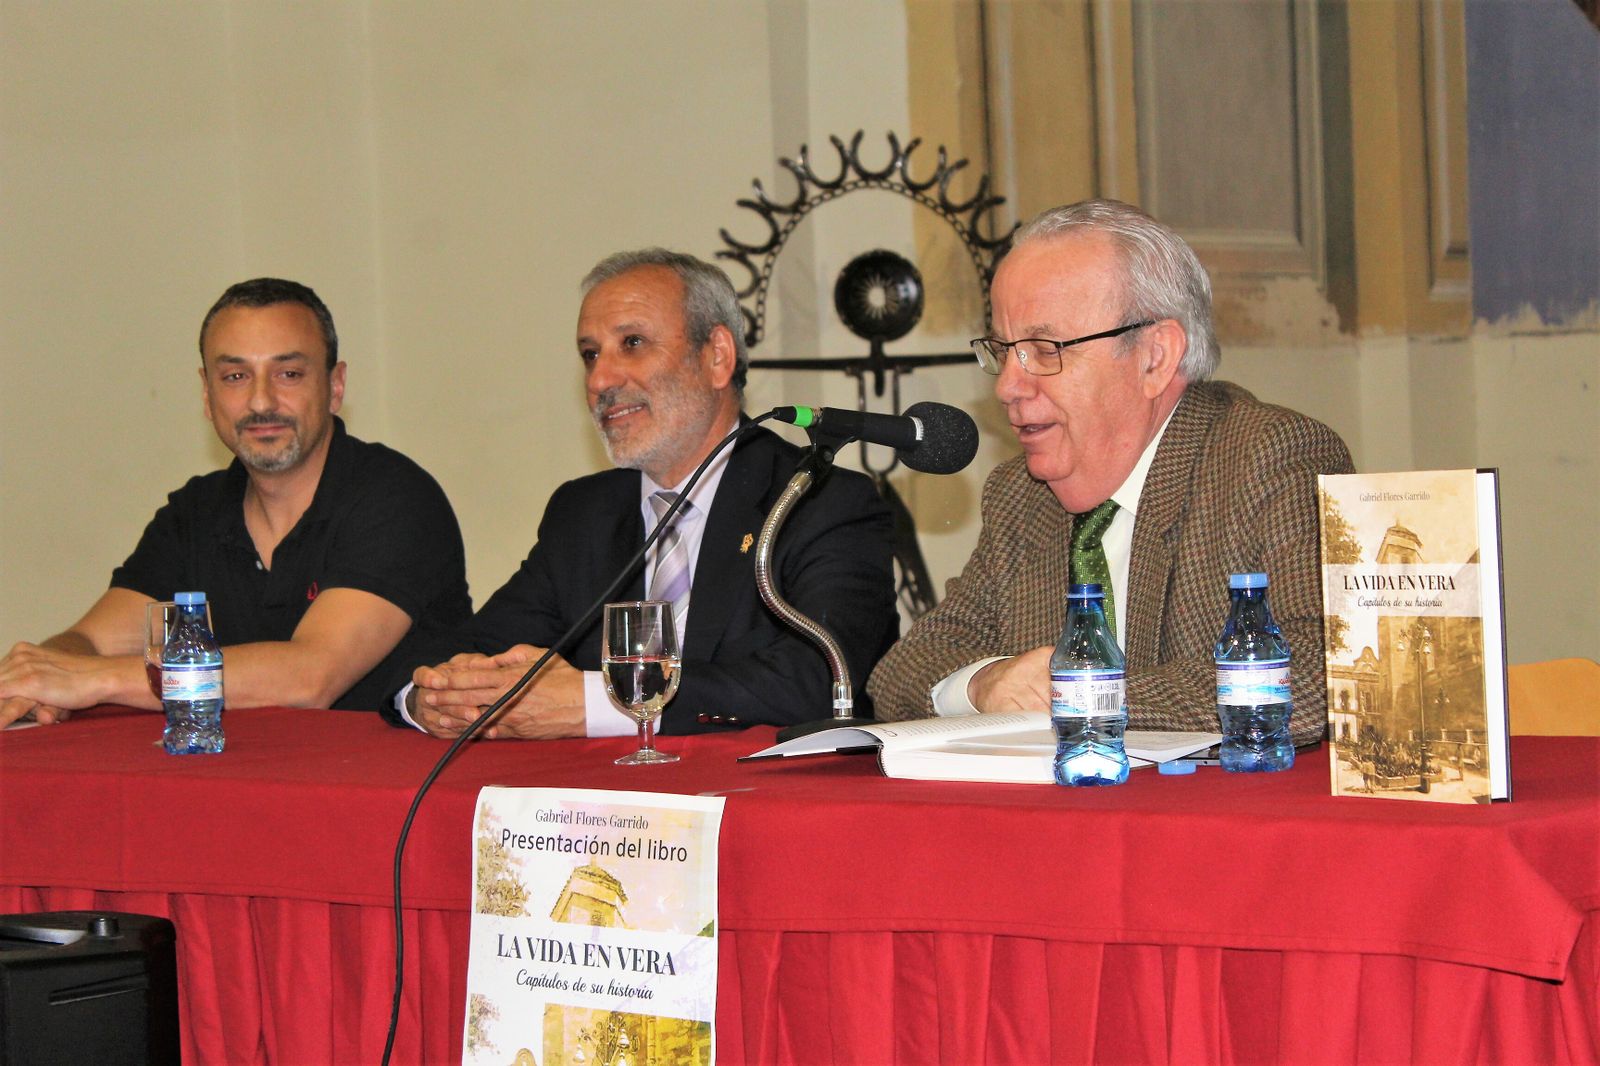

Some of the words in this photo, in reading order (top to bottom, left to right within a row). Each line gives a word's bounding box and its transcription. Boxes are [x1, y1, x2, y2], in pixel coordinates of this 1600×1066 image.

[1359, 492, 1383, 502] Gabriel
[1383, 491, 1404, 502] Flores
[1404, 491, 1431, 501] Garrido
[1344, 575, 1360, 590] LA
[1361, 575, 1395, 590] VIDA
[1398, 575, 1416, 590] EN
[1418, 575, 1456, 590] VERA
[1393, 597, 1401, 607] de
[1414, 597, 1443, 607] historia
[535, 808, 573, 825] Gabriel
[575, 811, 607, 828] Flores
[609, 814, 649, 830] Garrido
[501, 828, 610, 856] Presentación
[616, 837, 641, 859] del
[648, 839, 688, 863] libro
[497, 933, 522, 960] LA
[526, 936, 577, 965] VIDA
[583, 942, 612, 969] EN
[616, 946, 677, 976] VERA
[516, 968, 569, 992] Capítulos
[572, 976, 587, 993] de
[590, 982, 604, 995] su
[607, 979, 655, 1000] historia
